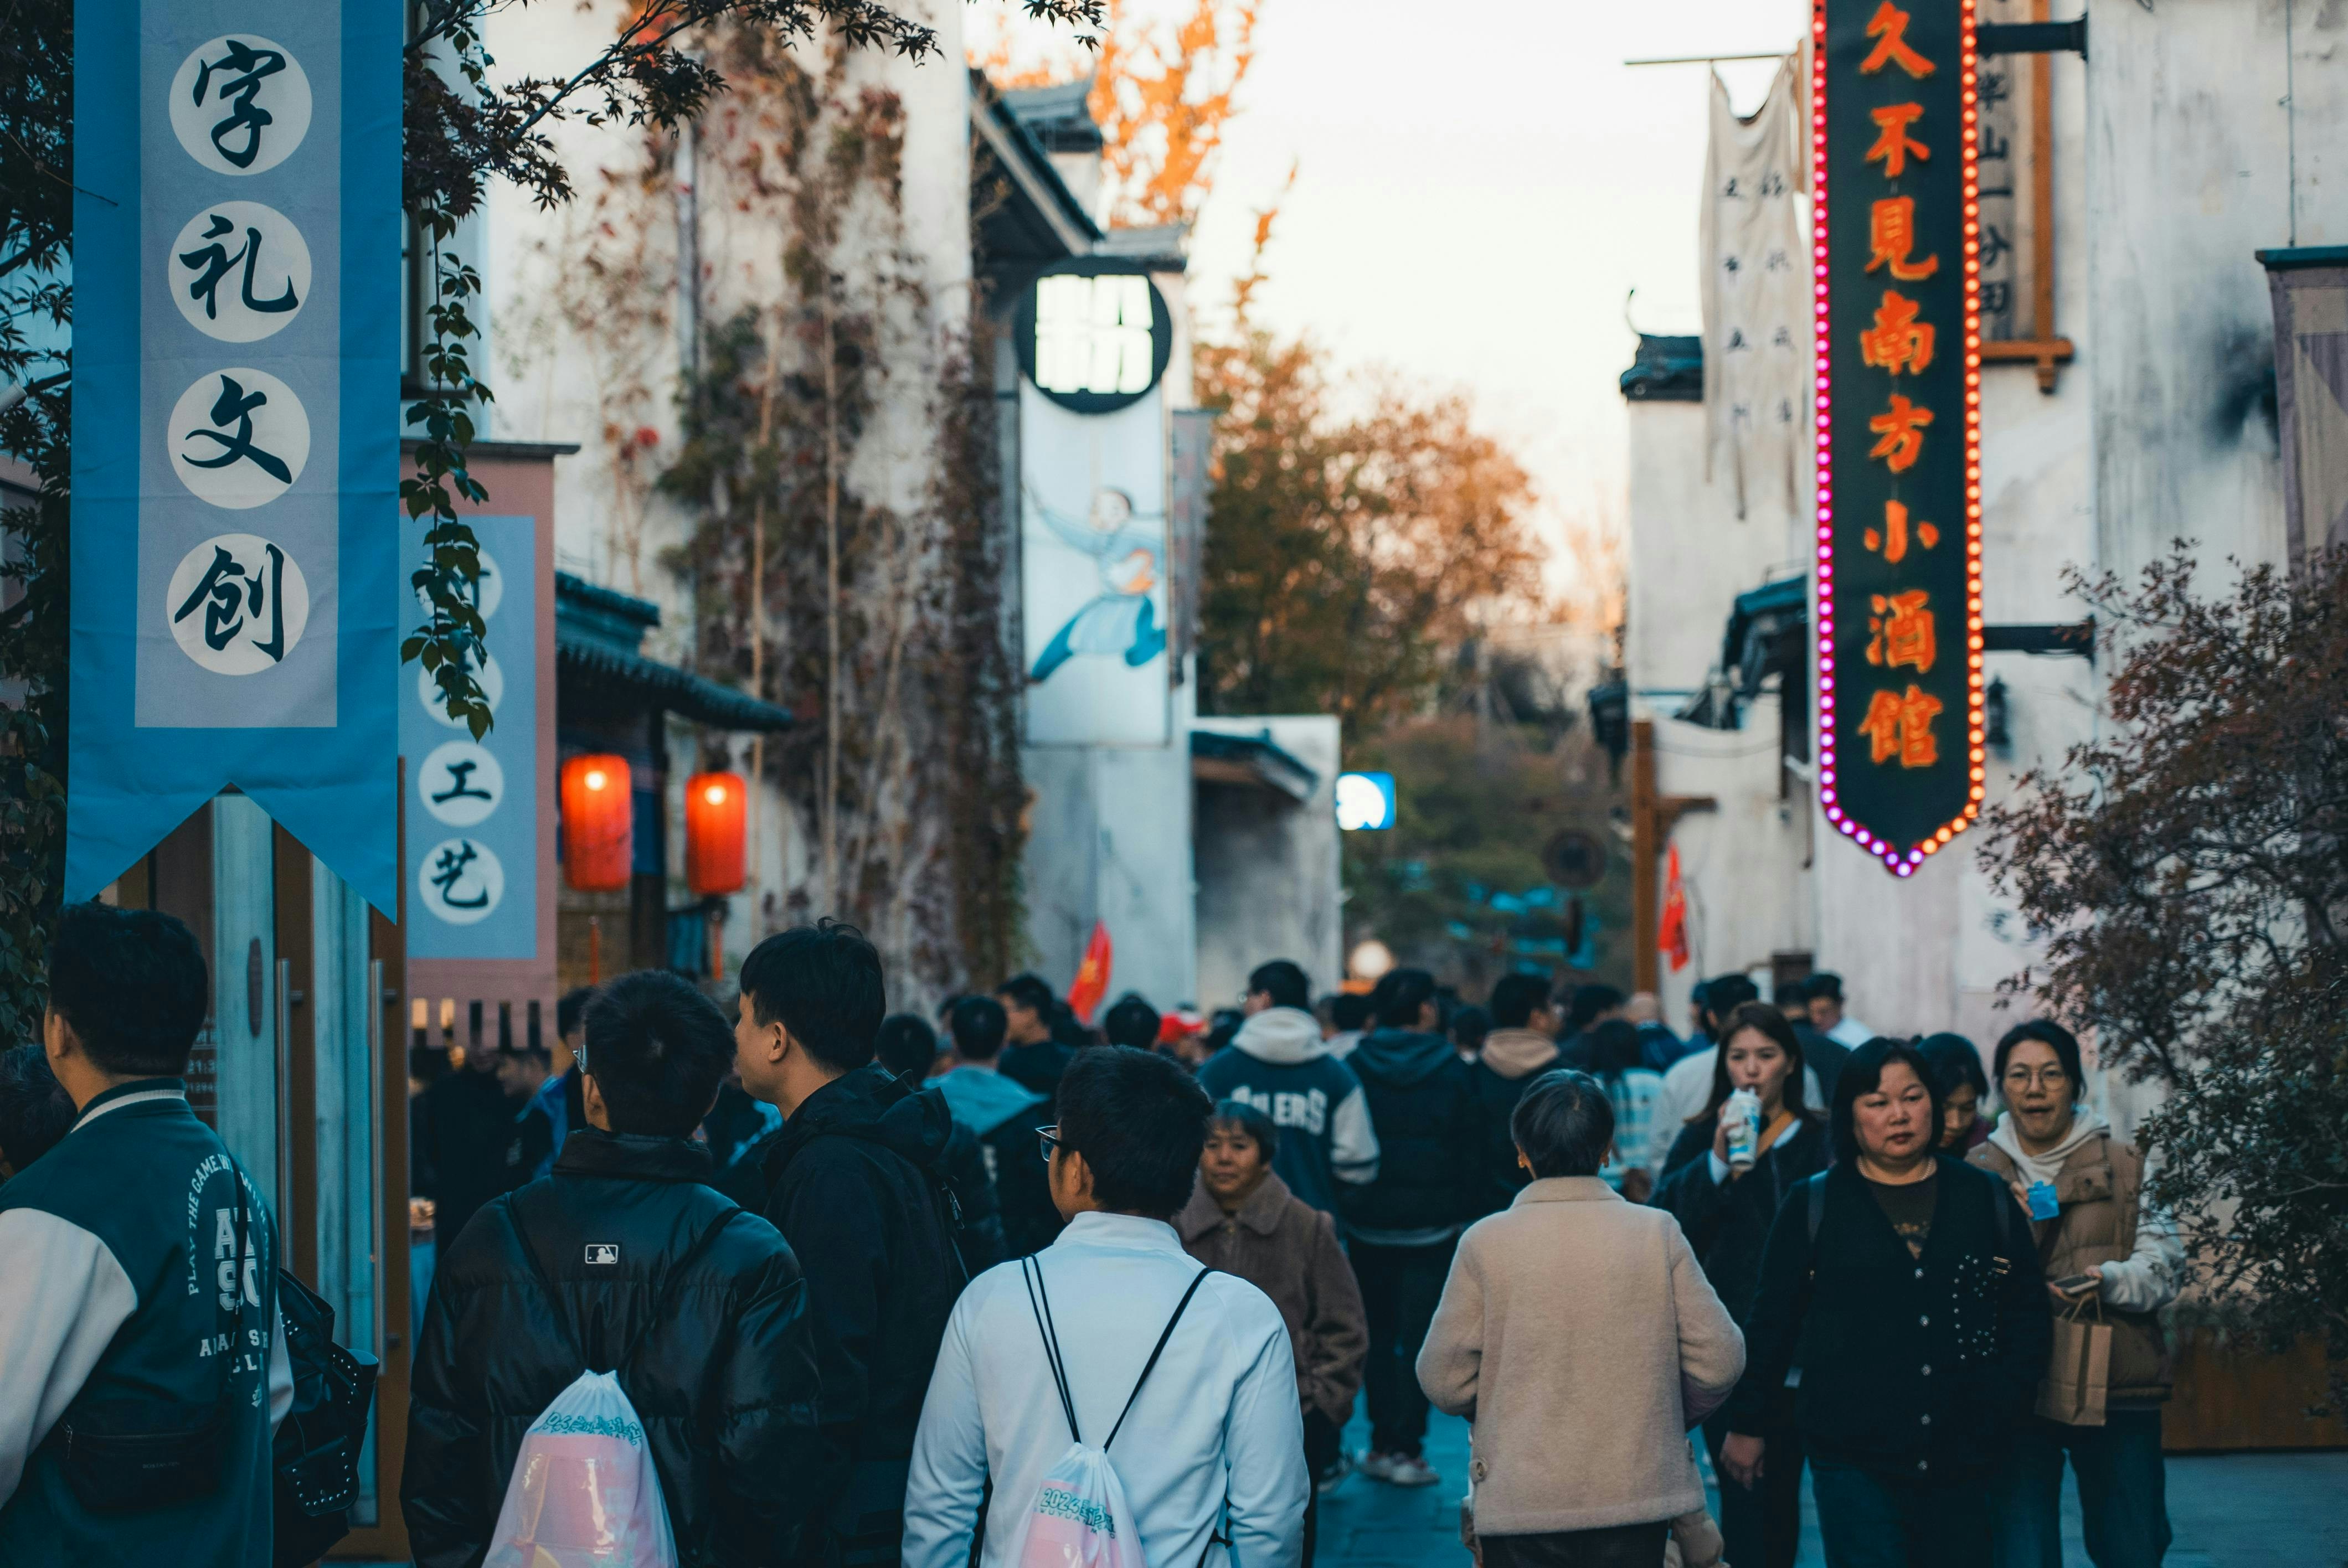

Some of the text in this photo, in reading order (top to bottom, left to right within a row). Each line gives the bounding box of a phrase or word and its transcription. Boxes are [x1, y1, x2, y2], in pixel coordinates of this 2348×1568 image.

[174, 39, 299, 663] 字礼文创
[1857, 1, 1944, 768] 久不見南方小酒館
[188, 1192, 199, 1230] THE
[188, 1236, 199, 1296] PLAY
